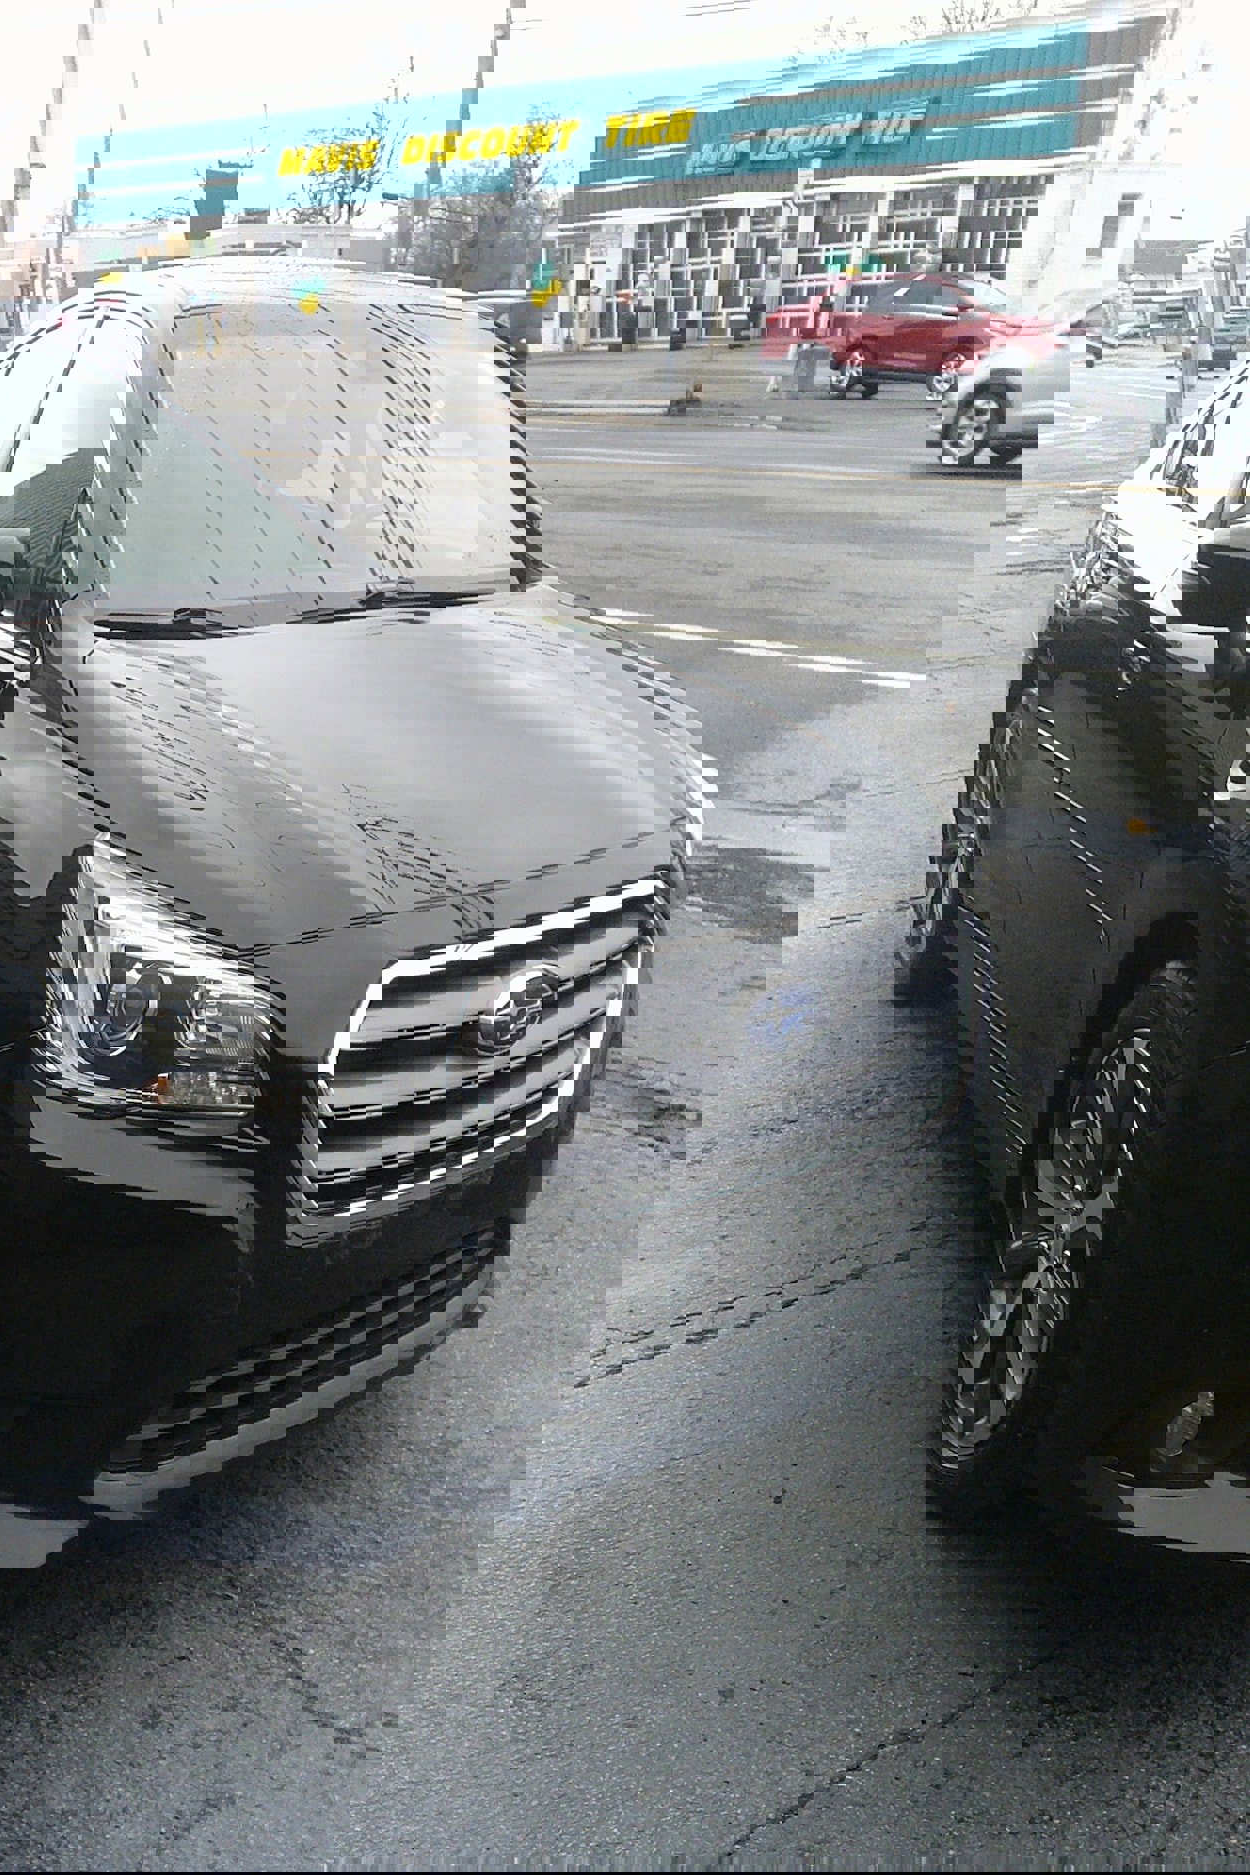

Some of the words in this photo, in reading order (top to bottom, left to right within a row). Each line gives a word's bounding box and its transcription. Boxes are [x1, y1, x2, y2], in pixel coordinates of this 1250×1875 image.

[277, 138, 381, 178] MAVIS
[401, 119, 581, 167] DISCOUNT
[605, 107, 698, 149] TIRE
